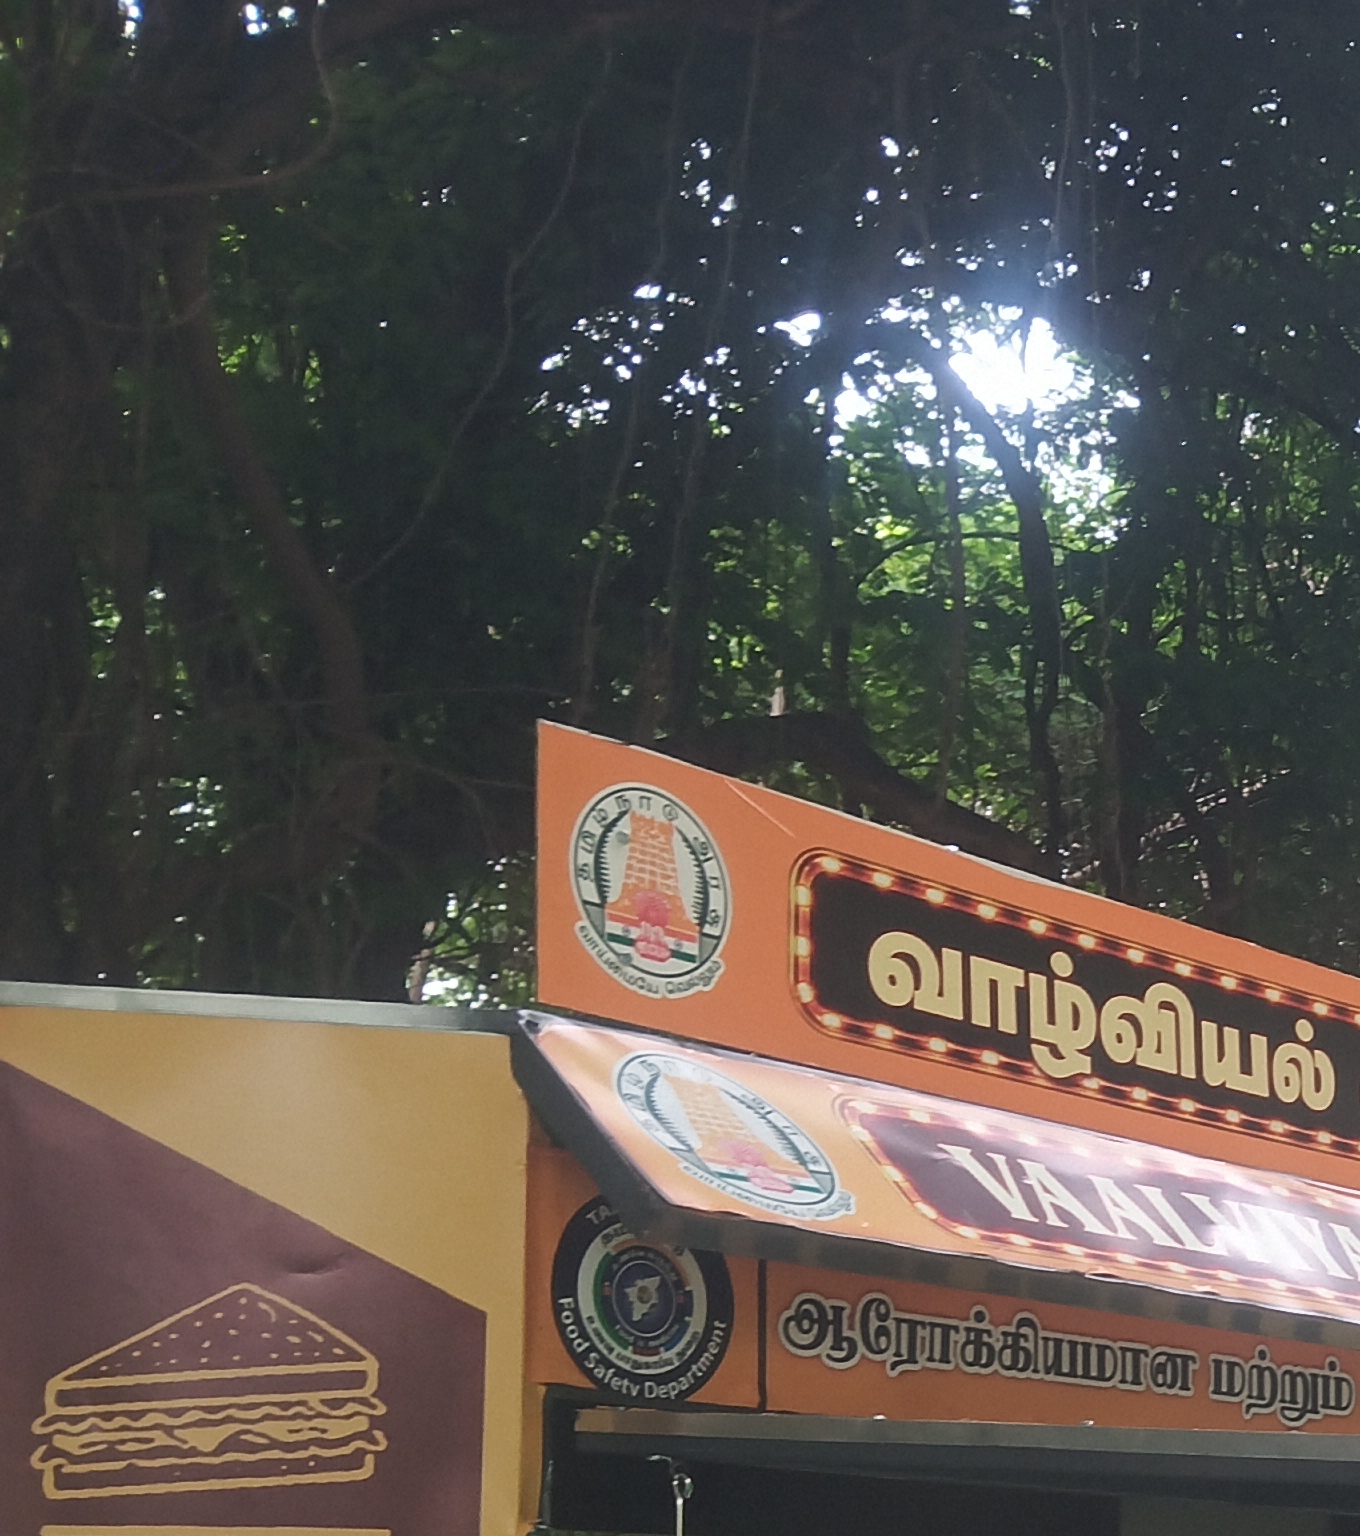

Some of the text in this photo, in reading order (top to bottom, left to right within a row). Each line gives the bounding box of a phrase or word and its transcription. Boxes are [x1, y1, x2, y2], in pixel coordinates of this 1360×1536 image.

[867, 931, 1335, 1111] வாழ்வியல்
[558, 1297, 728, 1400] Food Safety Department
[782, 1293, 1198, 1393] ஆரோக்கியமான
[1210, 1346, 1354, 1424] மற்றும்
